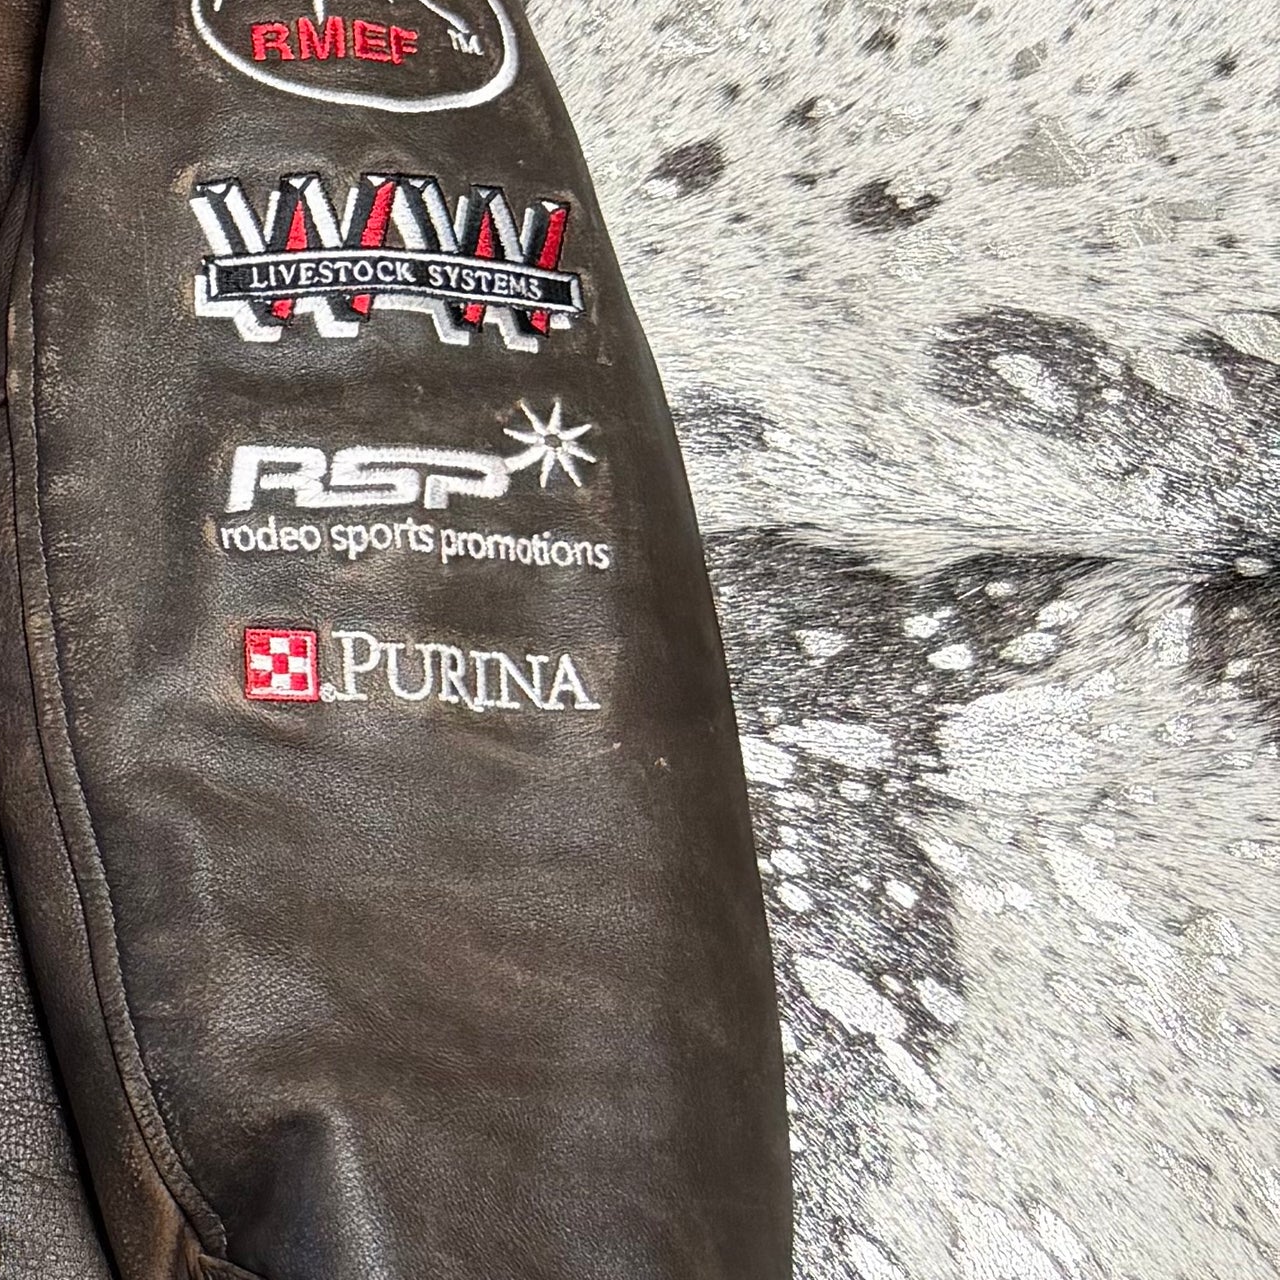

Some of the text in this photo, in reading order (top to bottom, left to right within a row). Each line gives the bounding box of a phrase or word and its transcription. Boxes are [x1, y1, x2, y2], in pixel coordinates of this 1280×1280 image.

[251, 16, 418, 65] RMEF
[248, 259, 541, 300] LIVESTOCK SYSTEMS
[224, 444, 510, 513] RSP
[220, 517, 610, 570] rodeo sports promotions
[332, 629, 602, 713] PURINA
